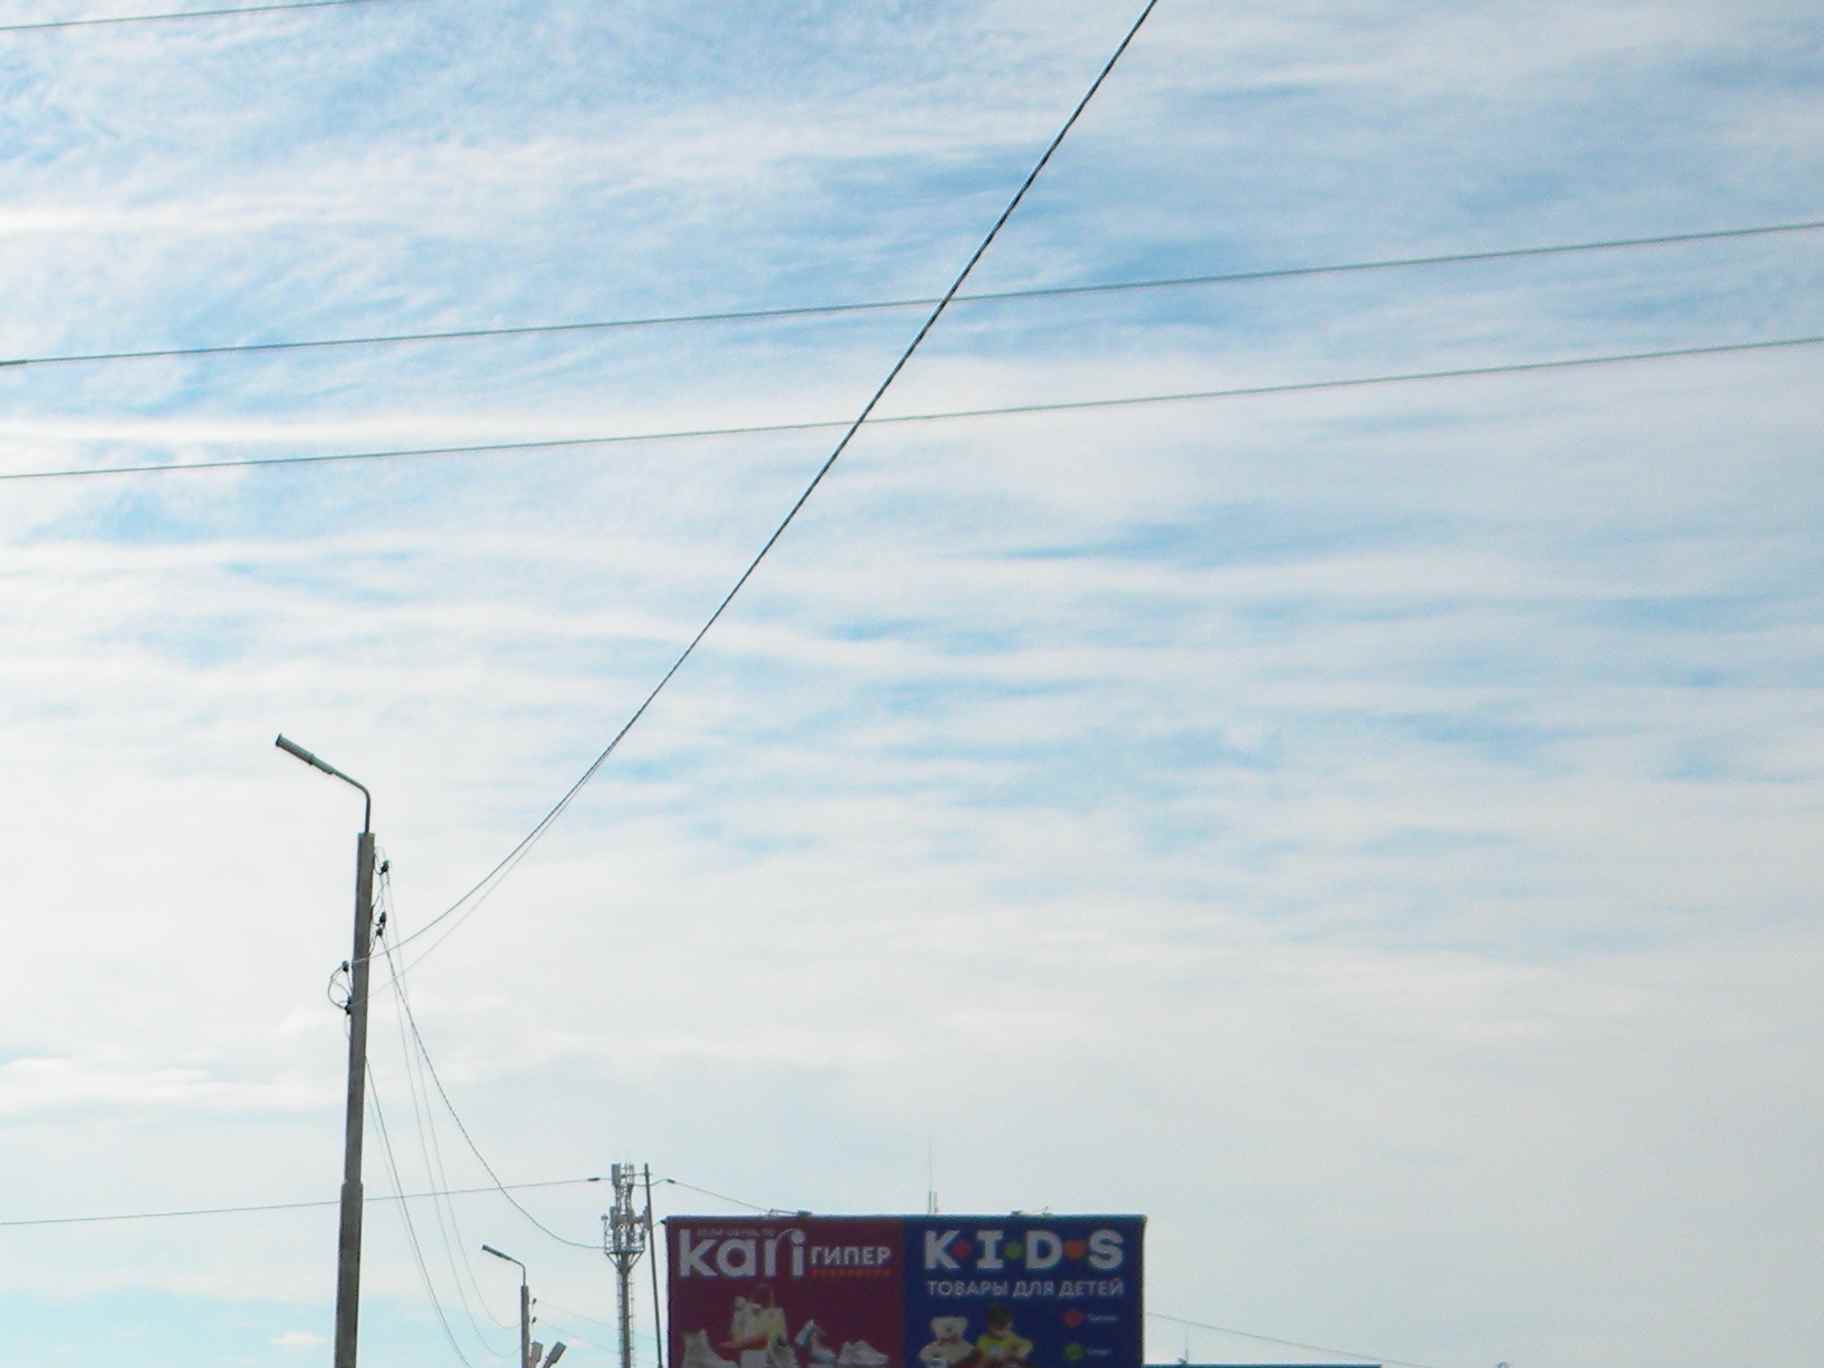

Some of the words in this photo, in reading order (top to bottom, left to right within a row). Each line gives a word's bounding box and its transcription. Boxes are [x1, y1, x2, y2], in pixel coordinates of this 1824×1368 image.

[679, 1228, 807, 1277] kari
[810, 1246, 891, 1266] ГИПЕР
[928, 1280, 1009, 1296] ТОВАРЫ
[1012, 1280, 1055, 1298] ДЛЯ
[1058, 1279, 1125, 1298] ДЕТЕЙ
